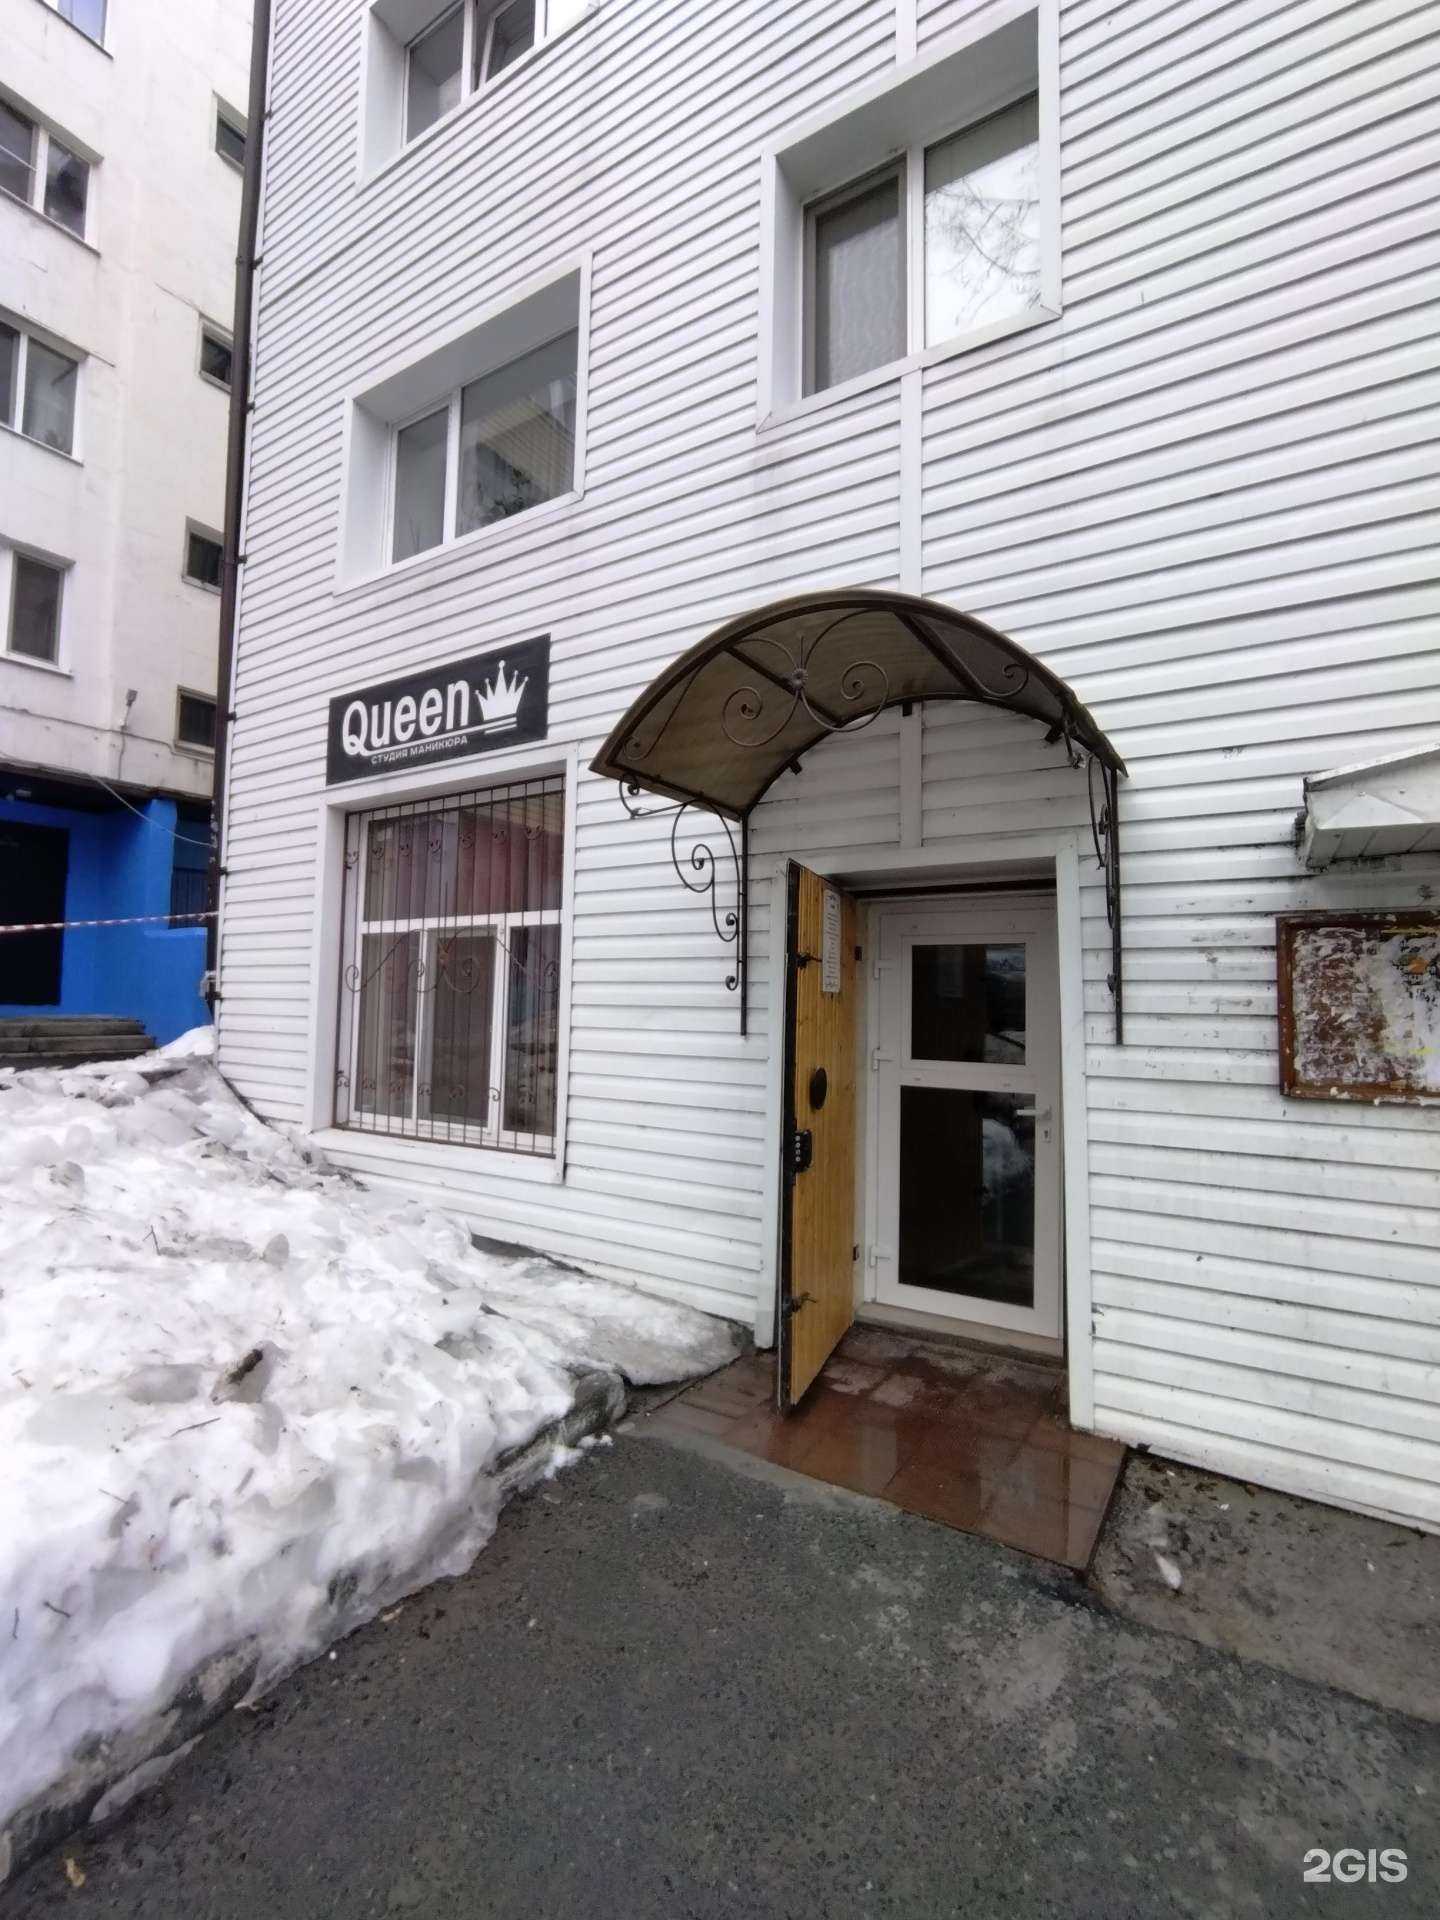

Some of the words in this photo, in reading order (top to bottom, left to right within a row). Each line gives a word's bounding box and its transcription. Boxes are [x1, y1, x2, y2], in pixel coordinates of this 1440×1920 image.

[342, 680, 469, 756] Queen
[371, 749, 408, 765] СТУДИЯ
[410, 735, 468, 757] МАНИКЮРА
